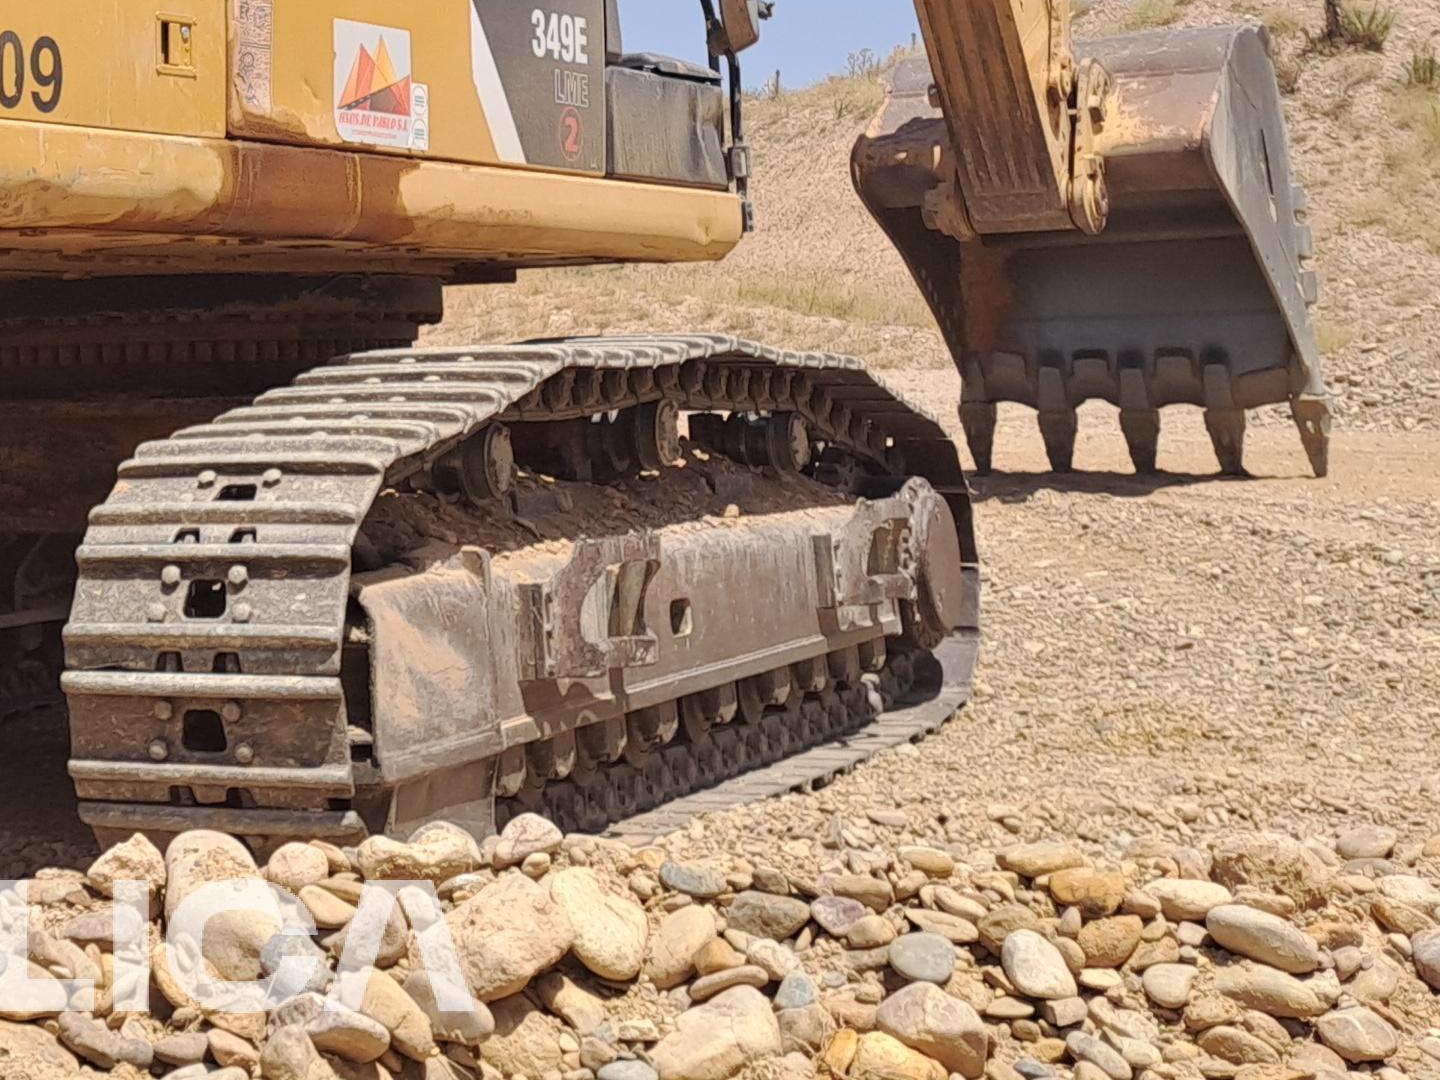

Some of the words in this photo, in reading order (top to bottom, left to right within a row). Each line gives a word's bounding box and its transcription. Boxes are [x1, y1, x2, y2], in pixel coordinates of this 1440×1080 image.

[531, 8, 589, 65] 349E
[554, 68, 589, 108] LME
[564, 116, 578, 153] 2
